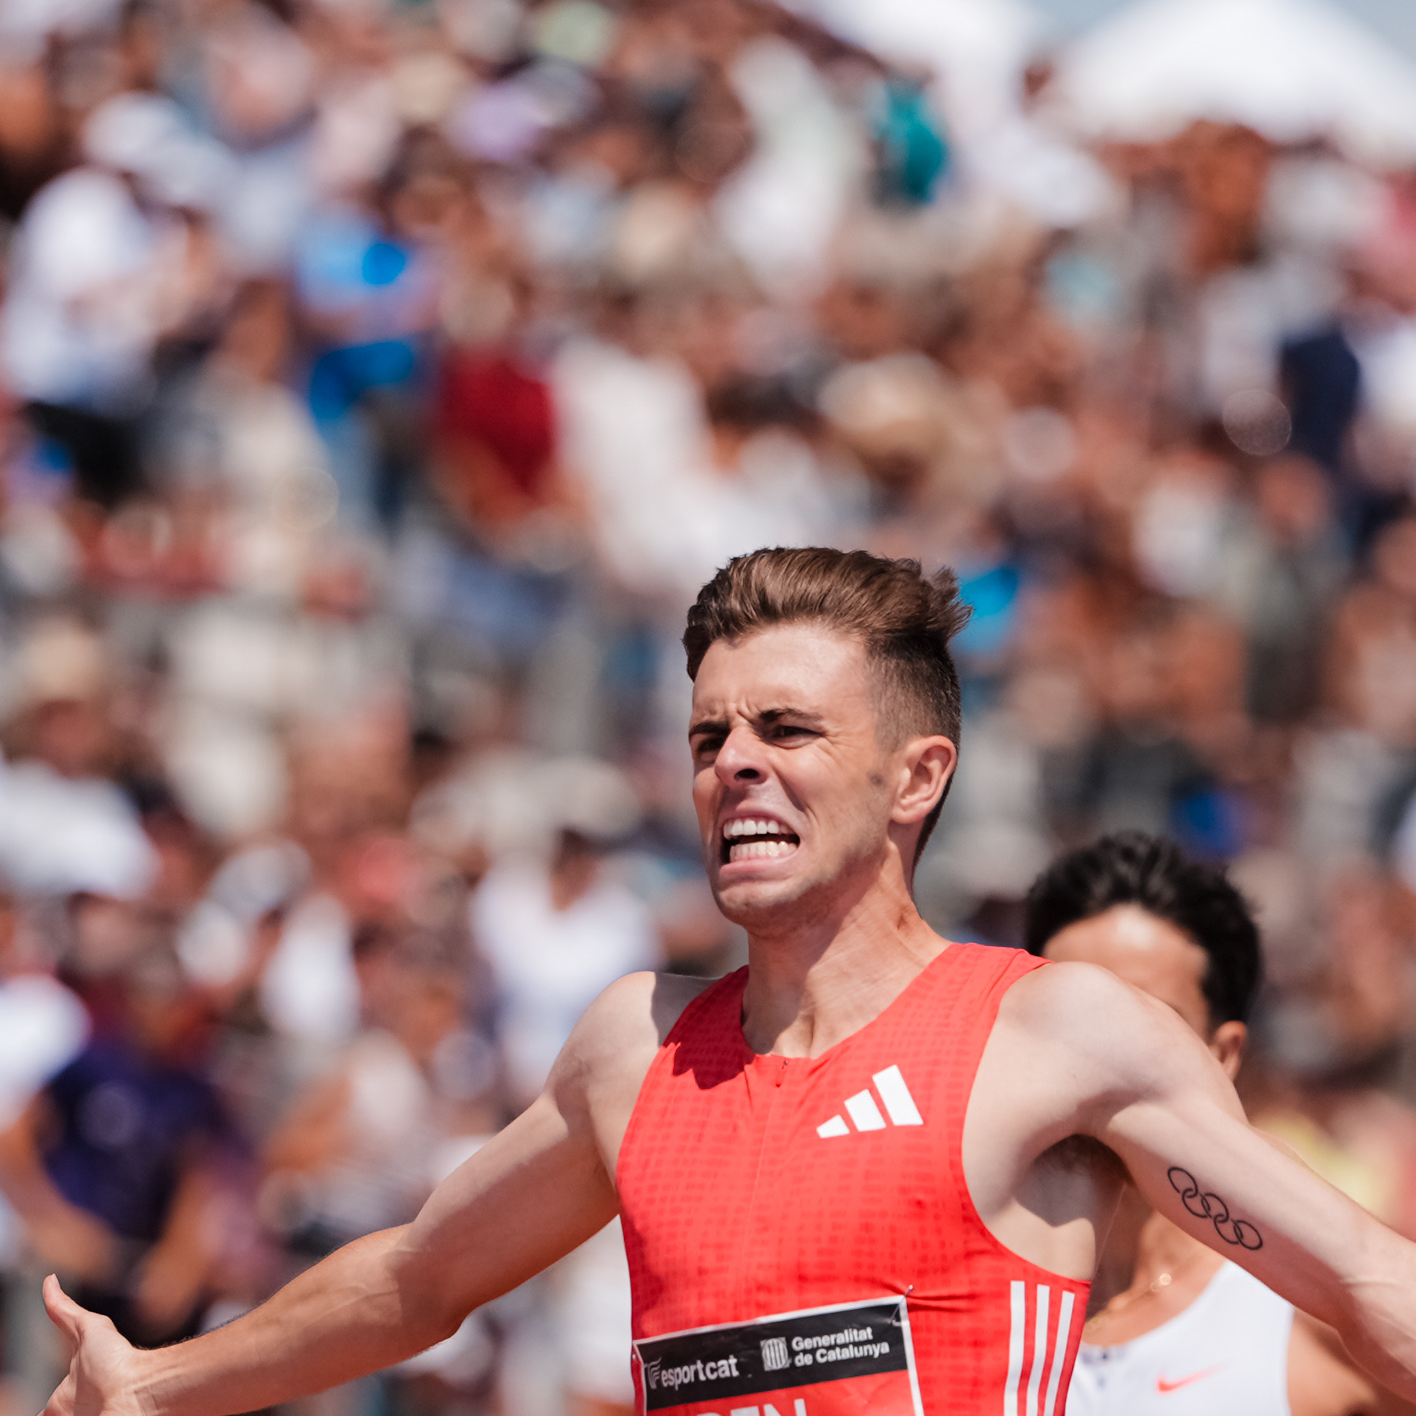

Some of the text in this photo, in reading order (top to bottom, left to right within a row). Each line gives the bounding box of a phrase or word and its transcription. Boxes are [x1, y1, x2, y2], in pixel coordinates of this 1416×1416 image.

[791, 1326, 874, 1351] Generalitat
[794, 1340, 891, 1368] de Catalunya
[660, 1354, 740, 1391] esportcat
